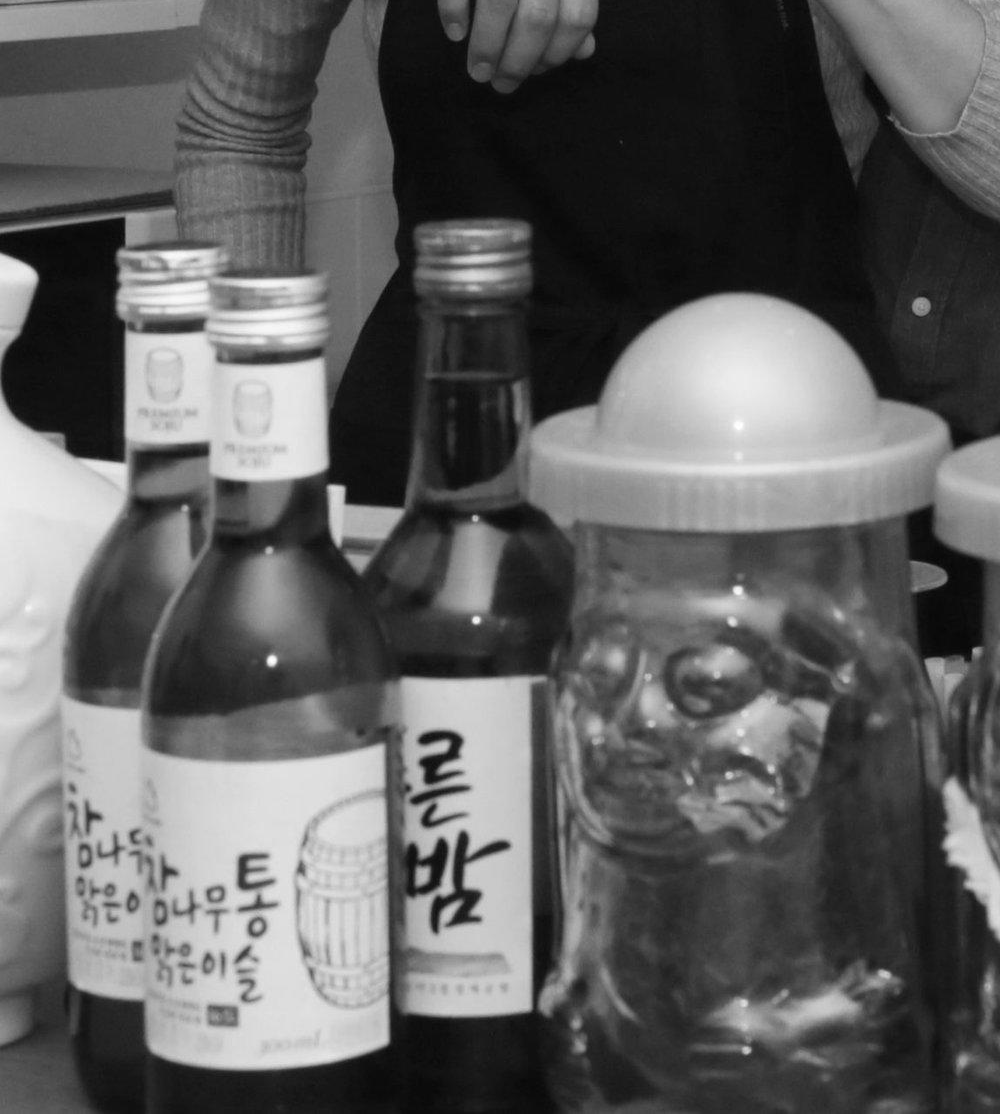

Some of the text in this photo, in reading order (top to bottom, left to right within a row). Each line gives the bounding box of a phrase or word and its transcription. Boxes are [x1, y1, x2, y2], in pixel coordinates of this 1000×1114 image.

[67, 781, 143, 875] 참나무
[404, 730, 511, 936] 른밤
[143, 832, 280, 939] 참나무통
